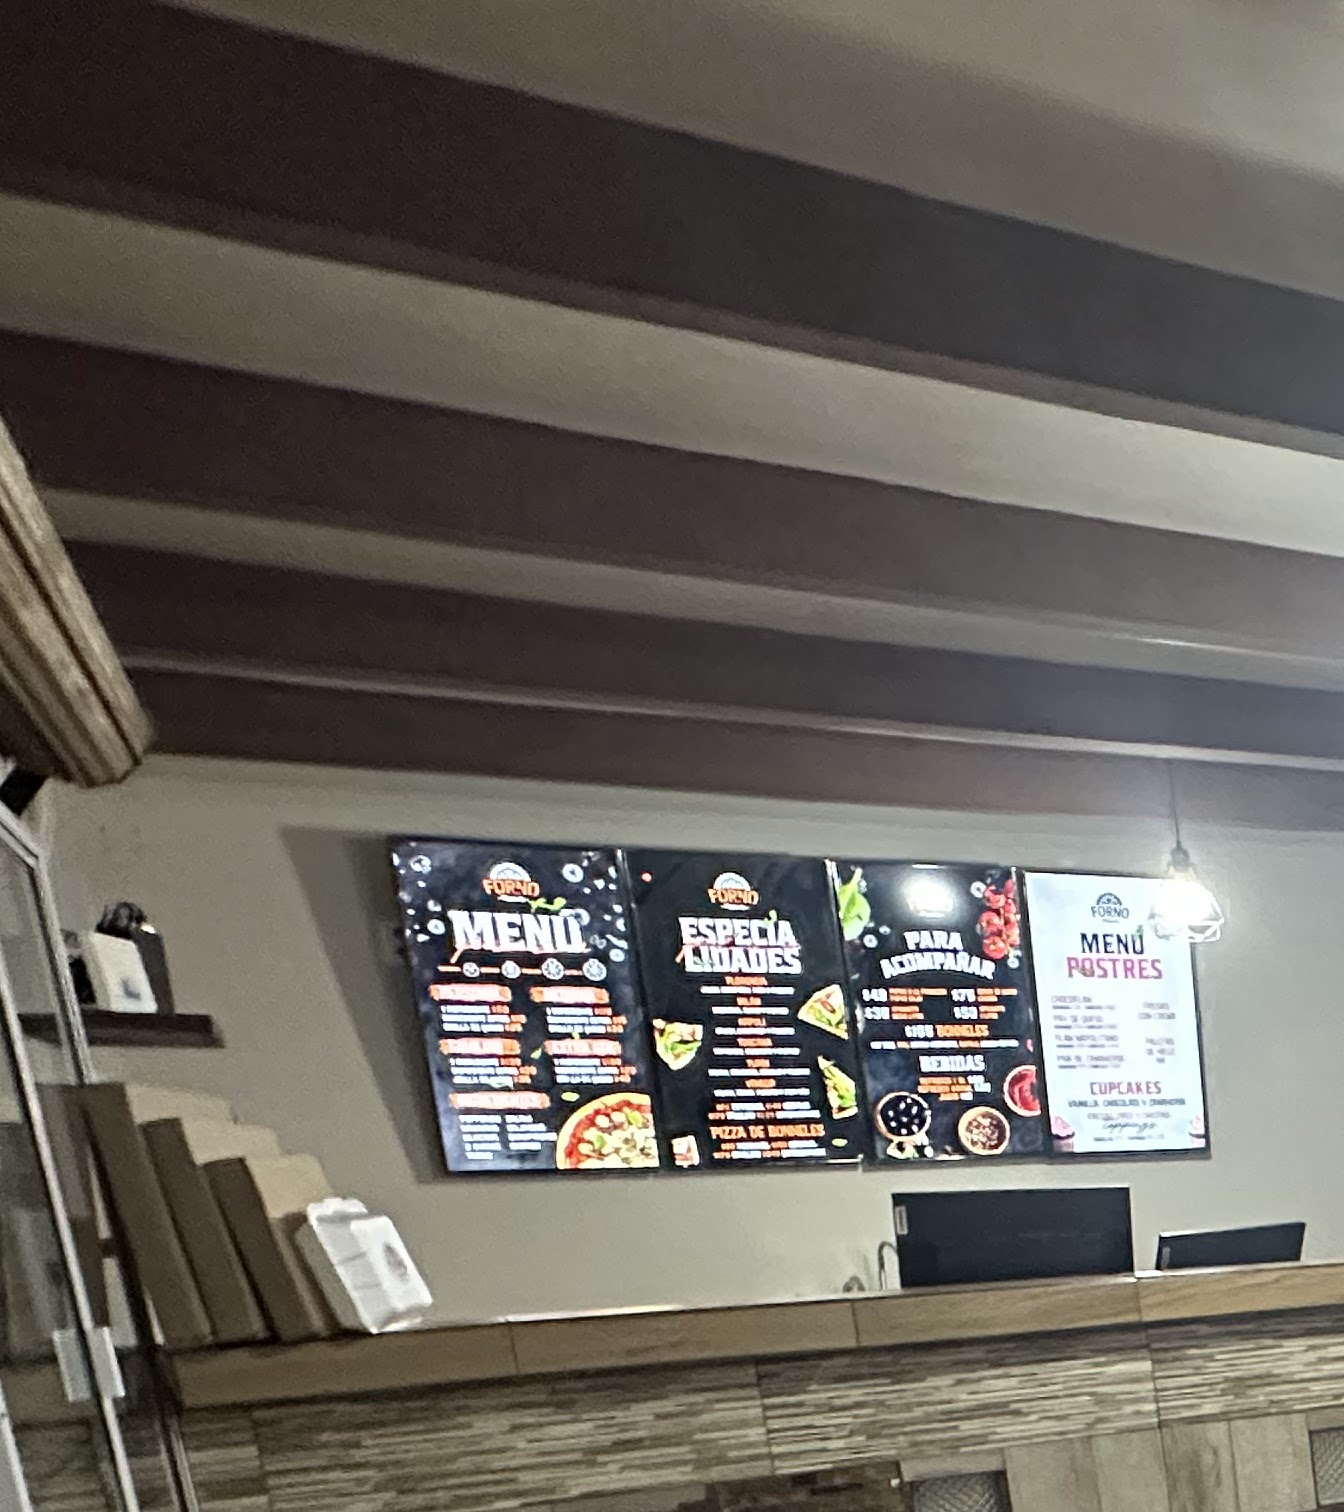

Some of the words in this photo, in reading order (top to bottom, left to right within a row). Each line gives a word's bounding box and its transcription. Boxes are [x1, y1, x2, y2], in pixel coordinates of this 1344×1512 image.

[1090, 905, 1130, 919] FORNO
[903, 930, 964, 951] PARA
[683, 945, 803, 974] LIDADES
[1066, 957, 1163, 980] POSTRES
[1089, 1081, 1162, 1096] CUPCAKES
[709, 1126, 747, 1140] PIZZA
